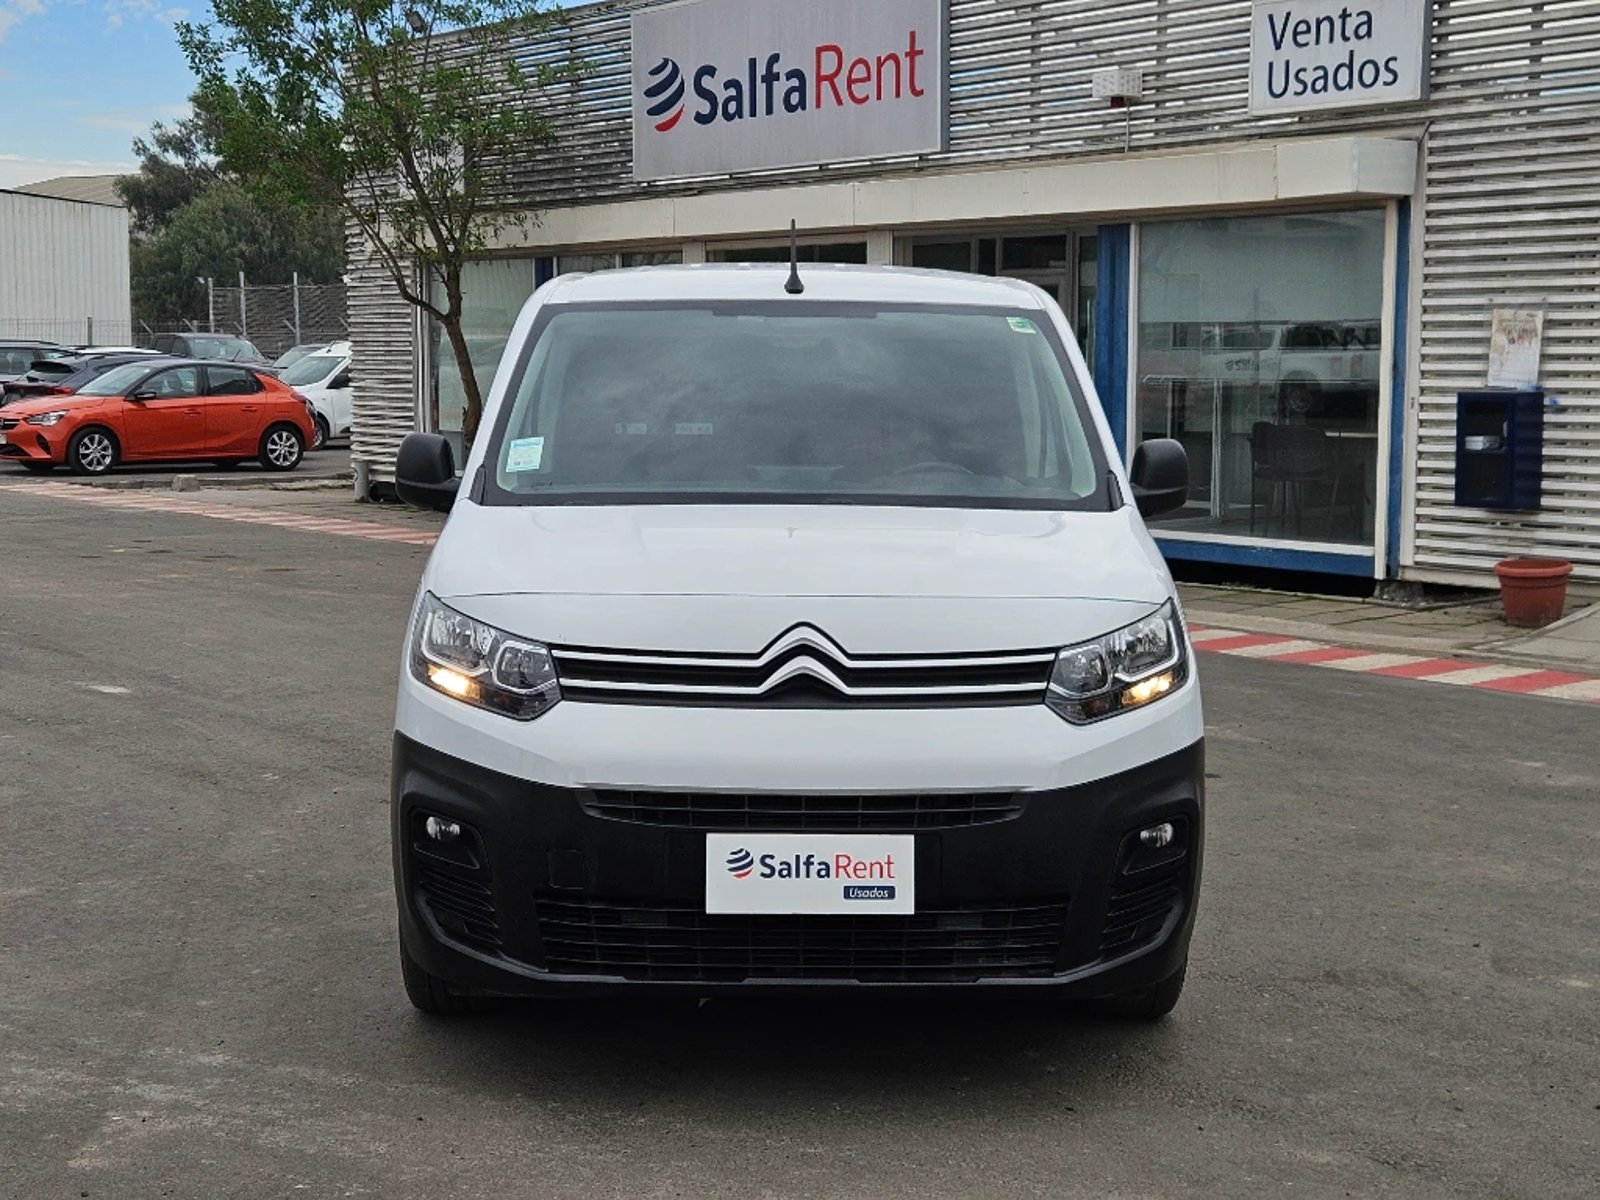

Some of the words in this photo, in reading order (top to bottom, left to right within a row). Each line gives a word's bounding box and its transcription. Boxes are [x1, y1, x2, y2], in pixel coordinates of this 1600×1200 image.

[1267, 7, 1373, 50] Venta
[693, 30, 924, 126] SalfaRent
[1267, 50, 1399, 99] Usados
[759, 854, 896, 879] SalfaRent
[849, 887, 889, 898] Usados
